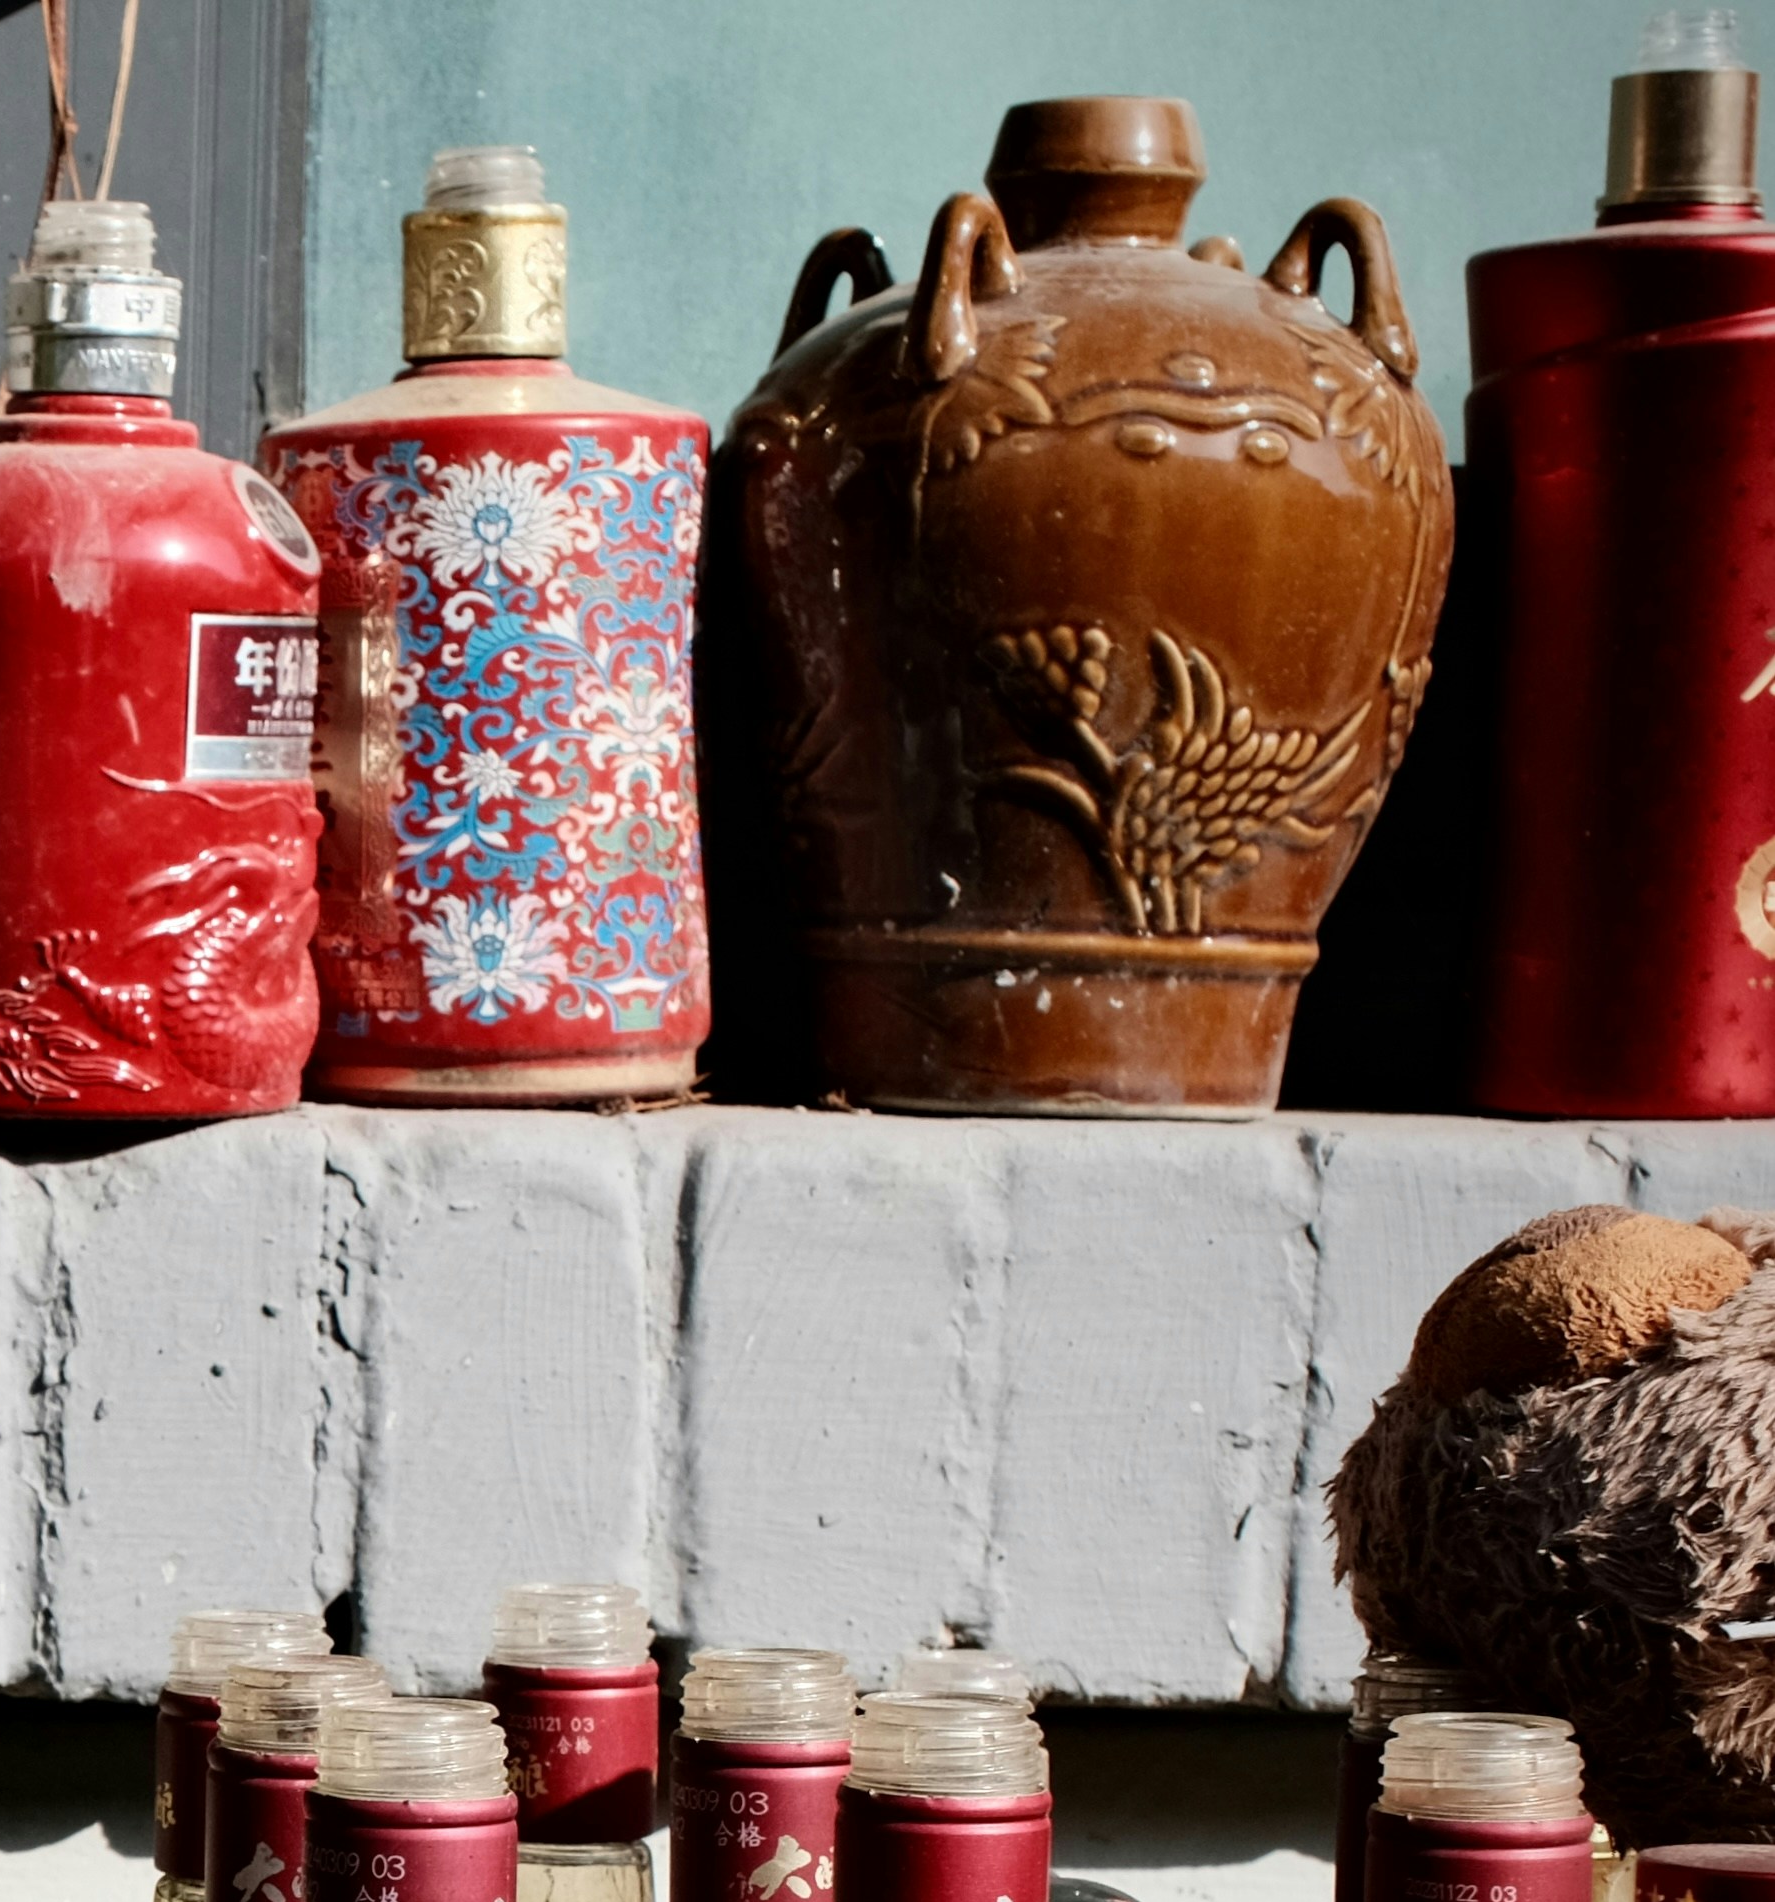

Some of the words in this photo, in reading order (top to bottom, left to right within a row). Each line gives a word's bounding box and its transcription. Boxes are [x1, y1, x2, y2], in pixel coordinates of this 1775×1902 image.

[569, 1717, 595, 1733] 03
[557, 1734, 592, 1755] 合格
[729, 1791, 769, 1815] 03
[714, 1821, 766, 1849] 合格
[371, 1855, 406, 1880] 03
